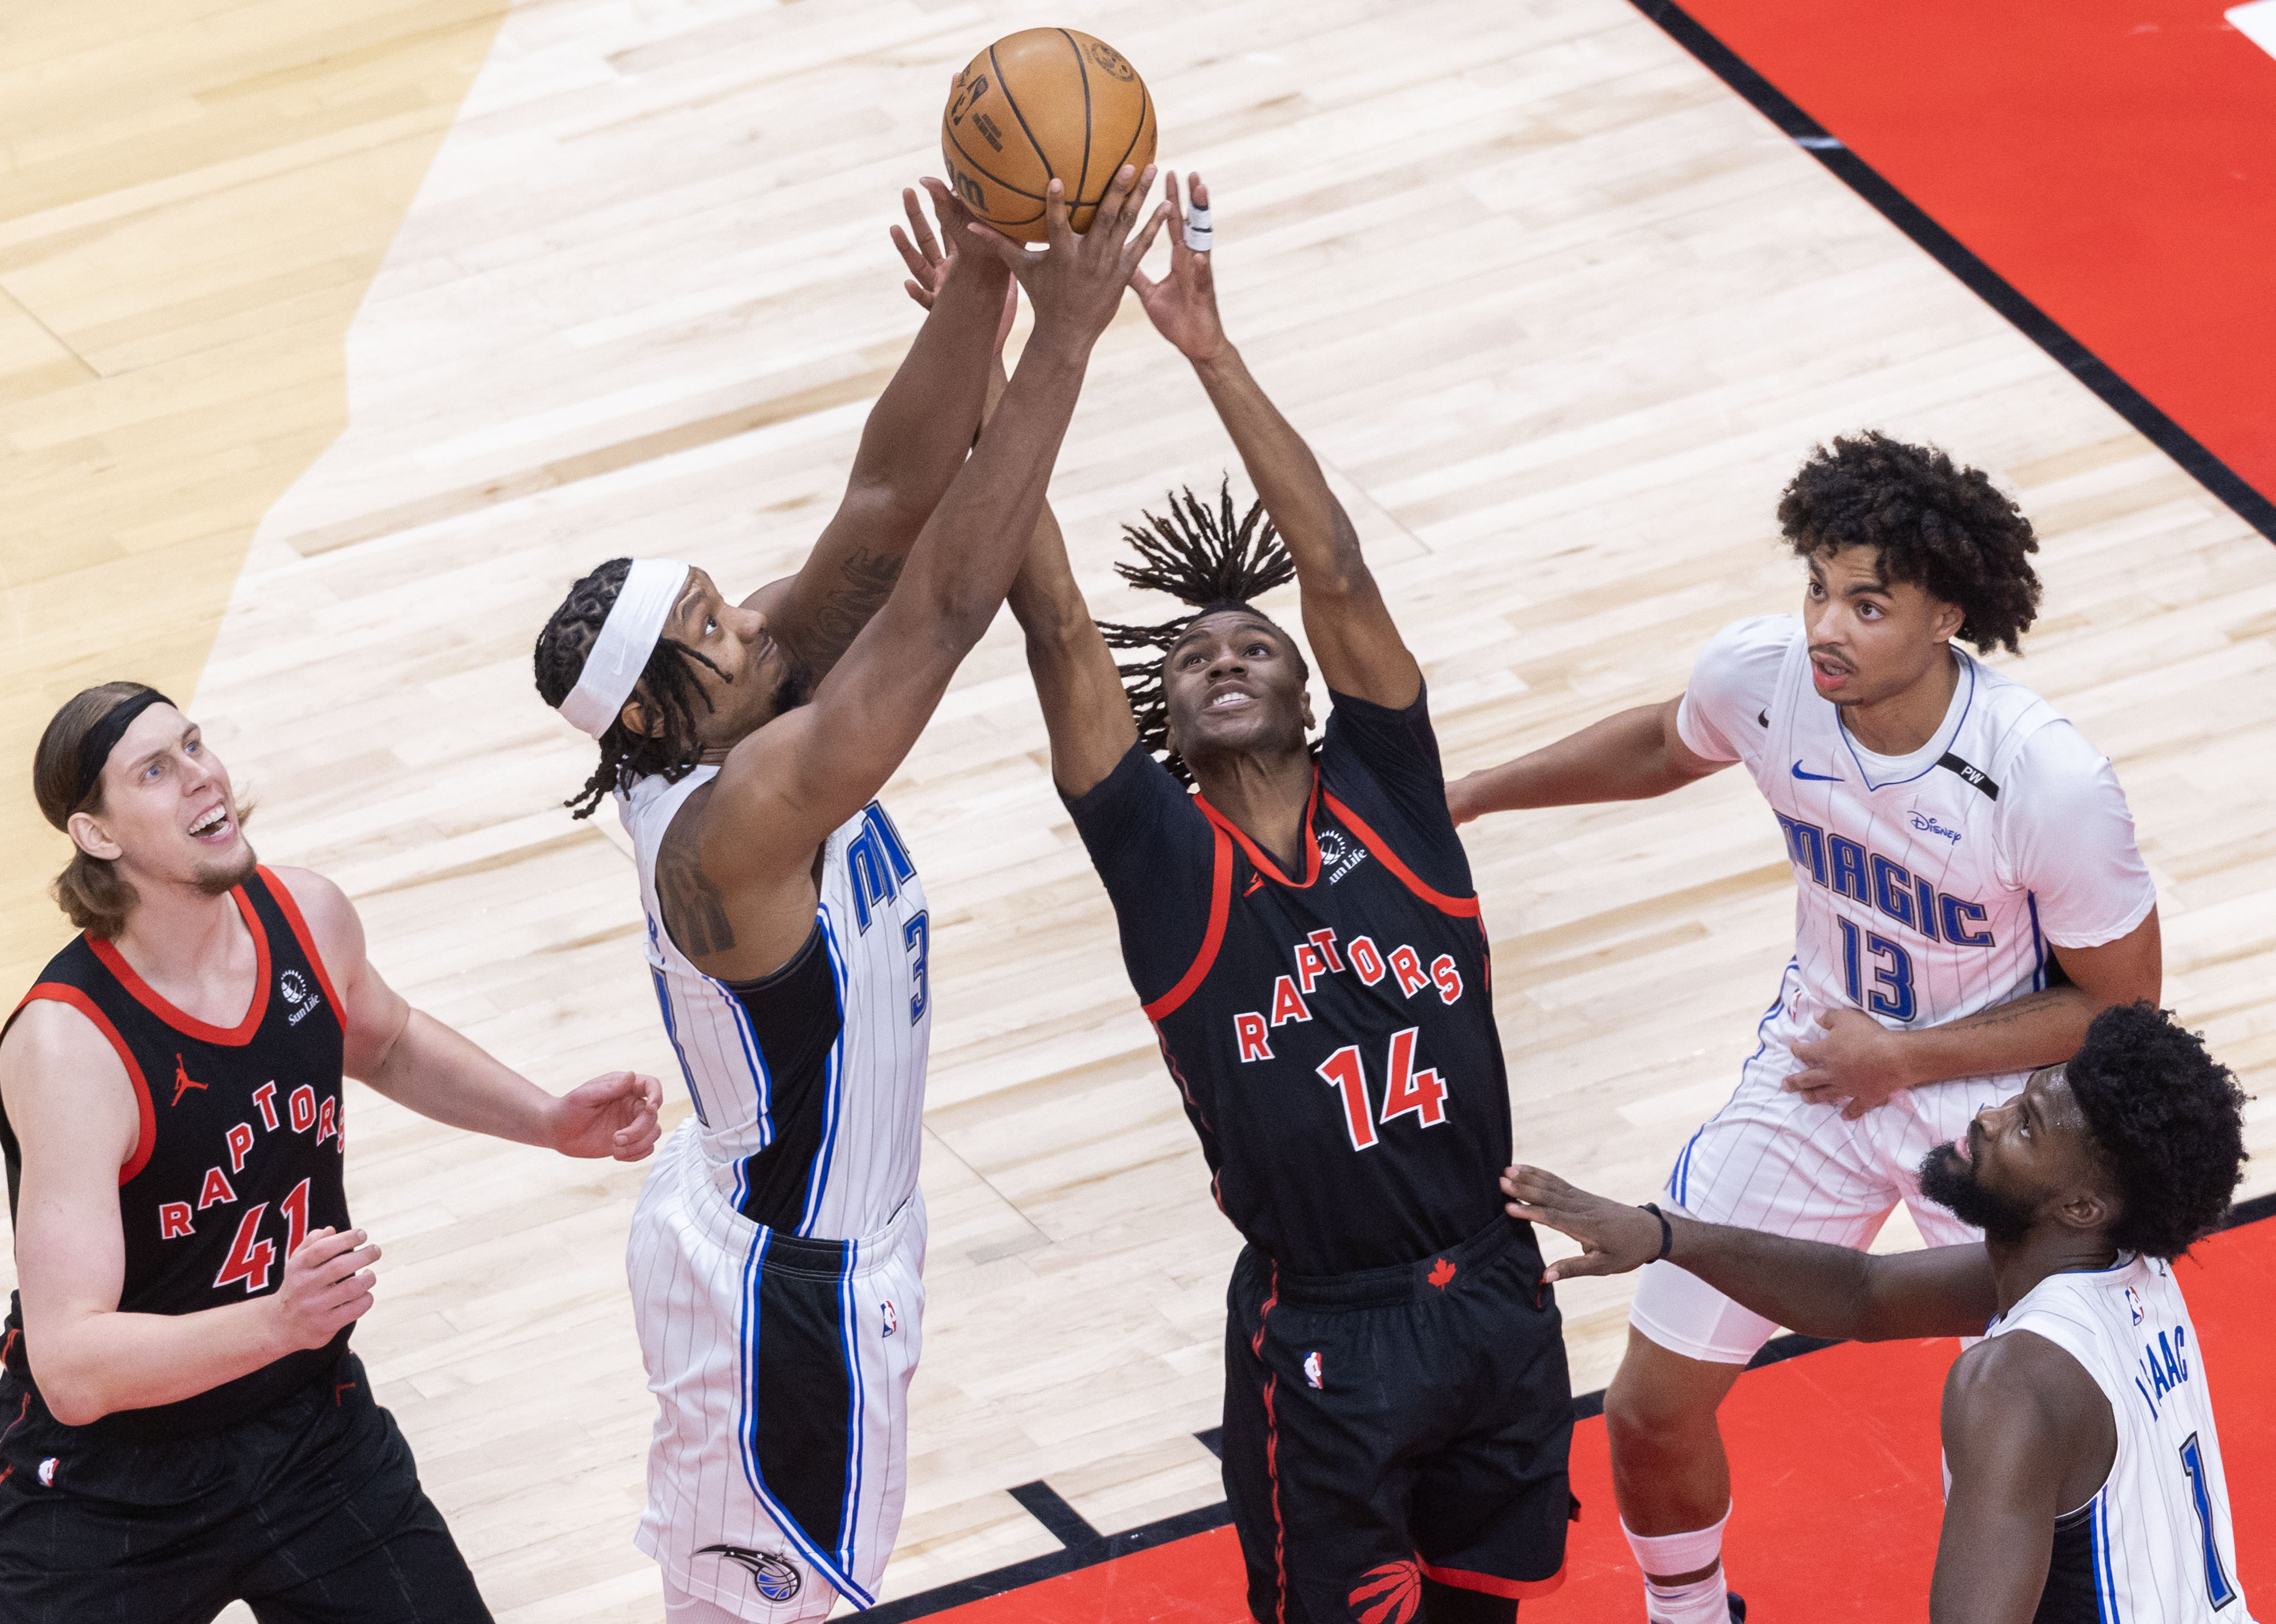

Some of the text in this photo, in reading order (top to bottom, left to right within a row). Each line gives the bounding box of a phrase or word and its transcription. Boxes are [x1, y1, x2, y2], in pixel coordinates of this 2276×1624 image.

[1907, 810, 1961, 846] Disney
[1961, 766, 1985, 784] PW
[1329, 849, 1368, 886] un Life
[1772, 809, 1995, 947] MAGIC
[288, 993, 320, 1027] Sun Life
[1234, 927, 1463, 1063] RAPTORS
[1837, 914, 1917, 1023] 13
[1316, 1026, 1449, 1152] 14
[212, 1177, 311, 1293] 41
[2179, 1431, 2237, 1613] 1
